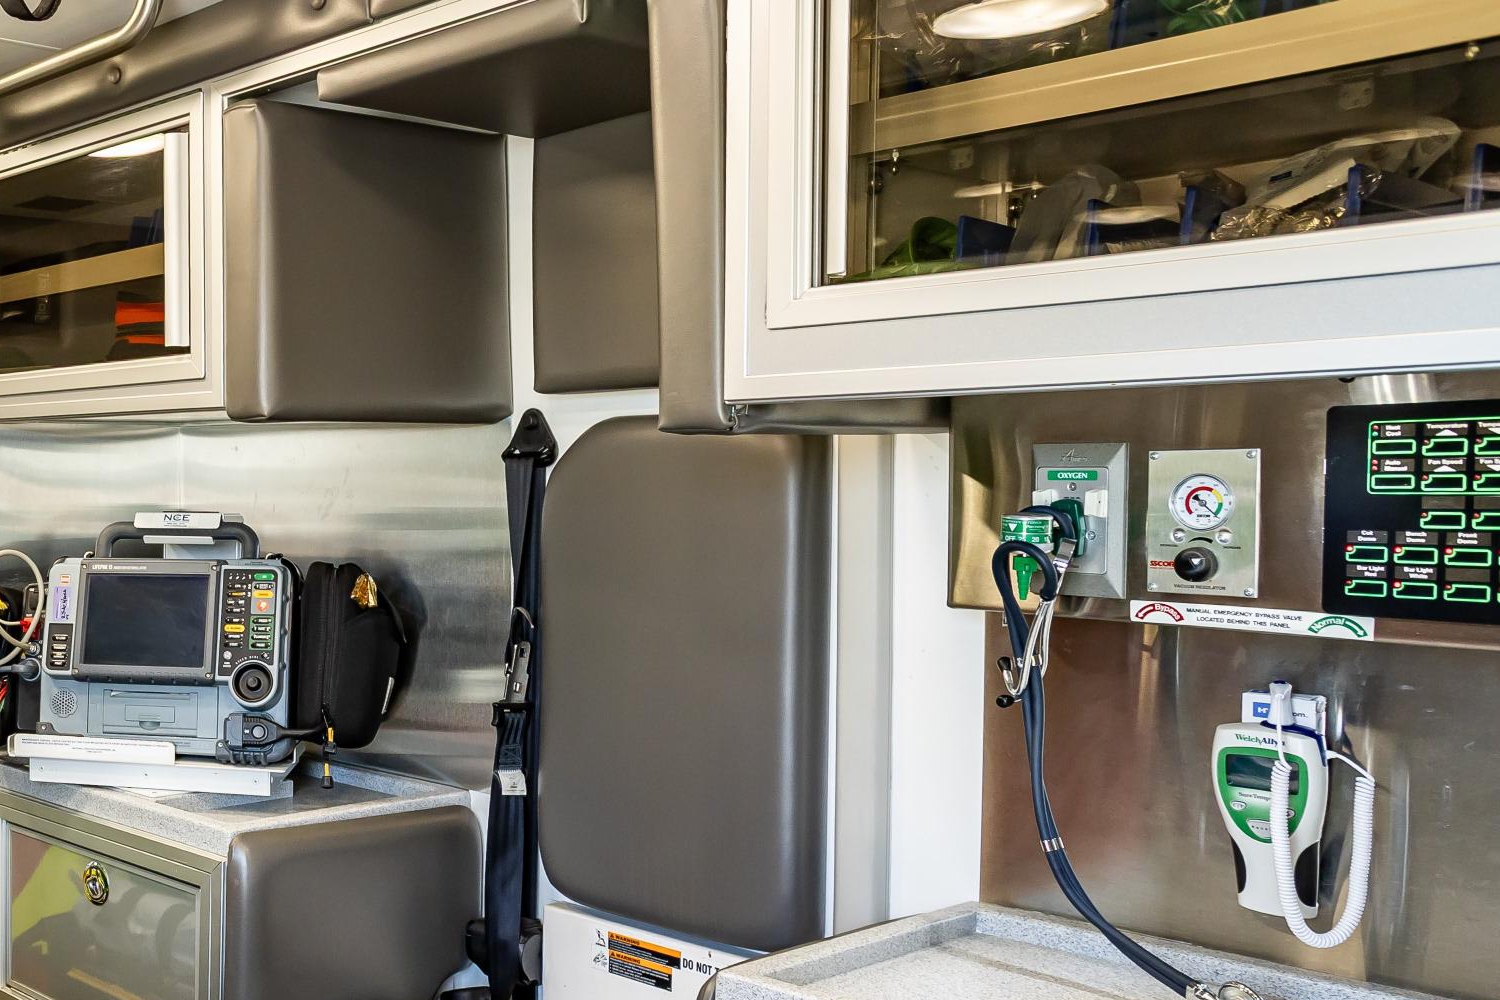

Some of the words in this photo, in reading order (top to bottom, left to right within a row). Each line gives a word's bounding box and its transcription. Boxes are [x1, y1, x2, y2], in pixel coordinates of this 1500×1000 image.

[163, 514, 191, 522] NCE
[1154, 603, 1181, 620] Bypass
[1213, 609, 1252, 617] EMERGENCY
[1255, 612, 1280, 620] BYPASS
[1310, 618, 1345, 631] Normal
[616, 934, 640, 945] WARNING
[616, 953, 641, 965] WARNING
[682, 957, 694, 970] DO
[696, 961, 712, 975] NOT
